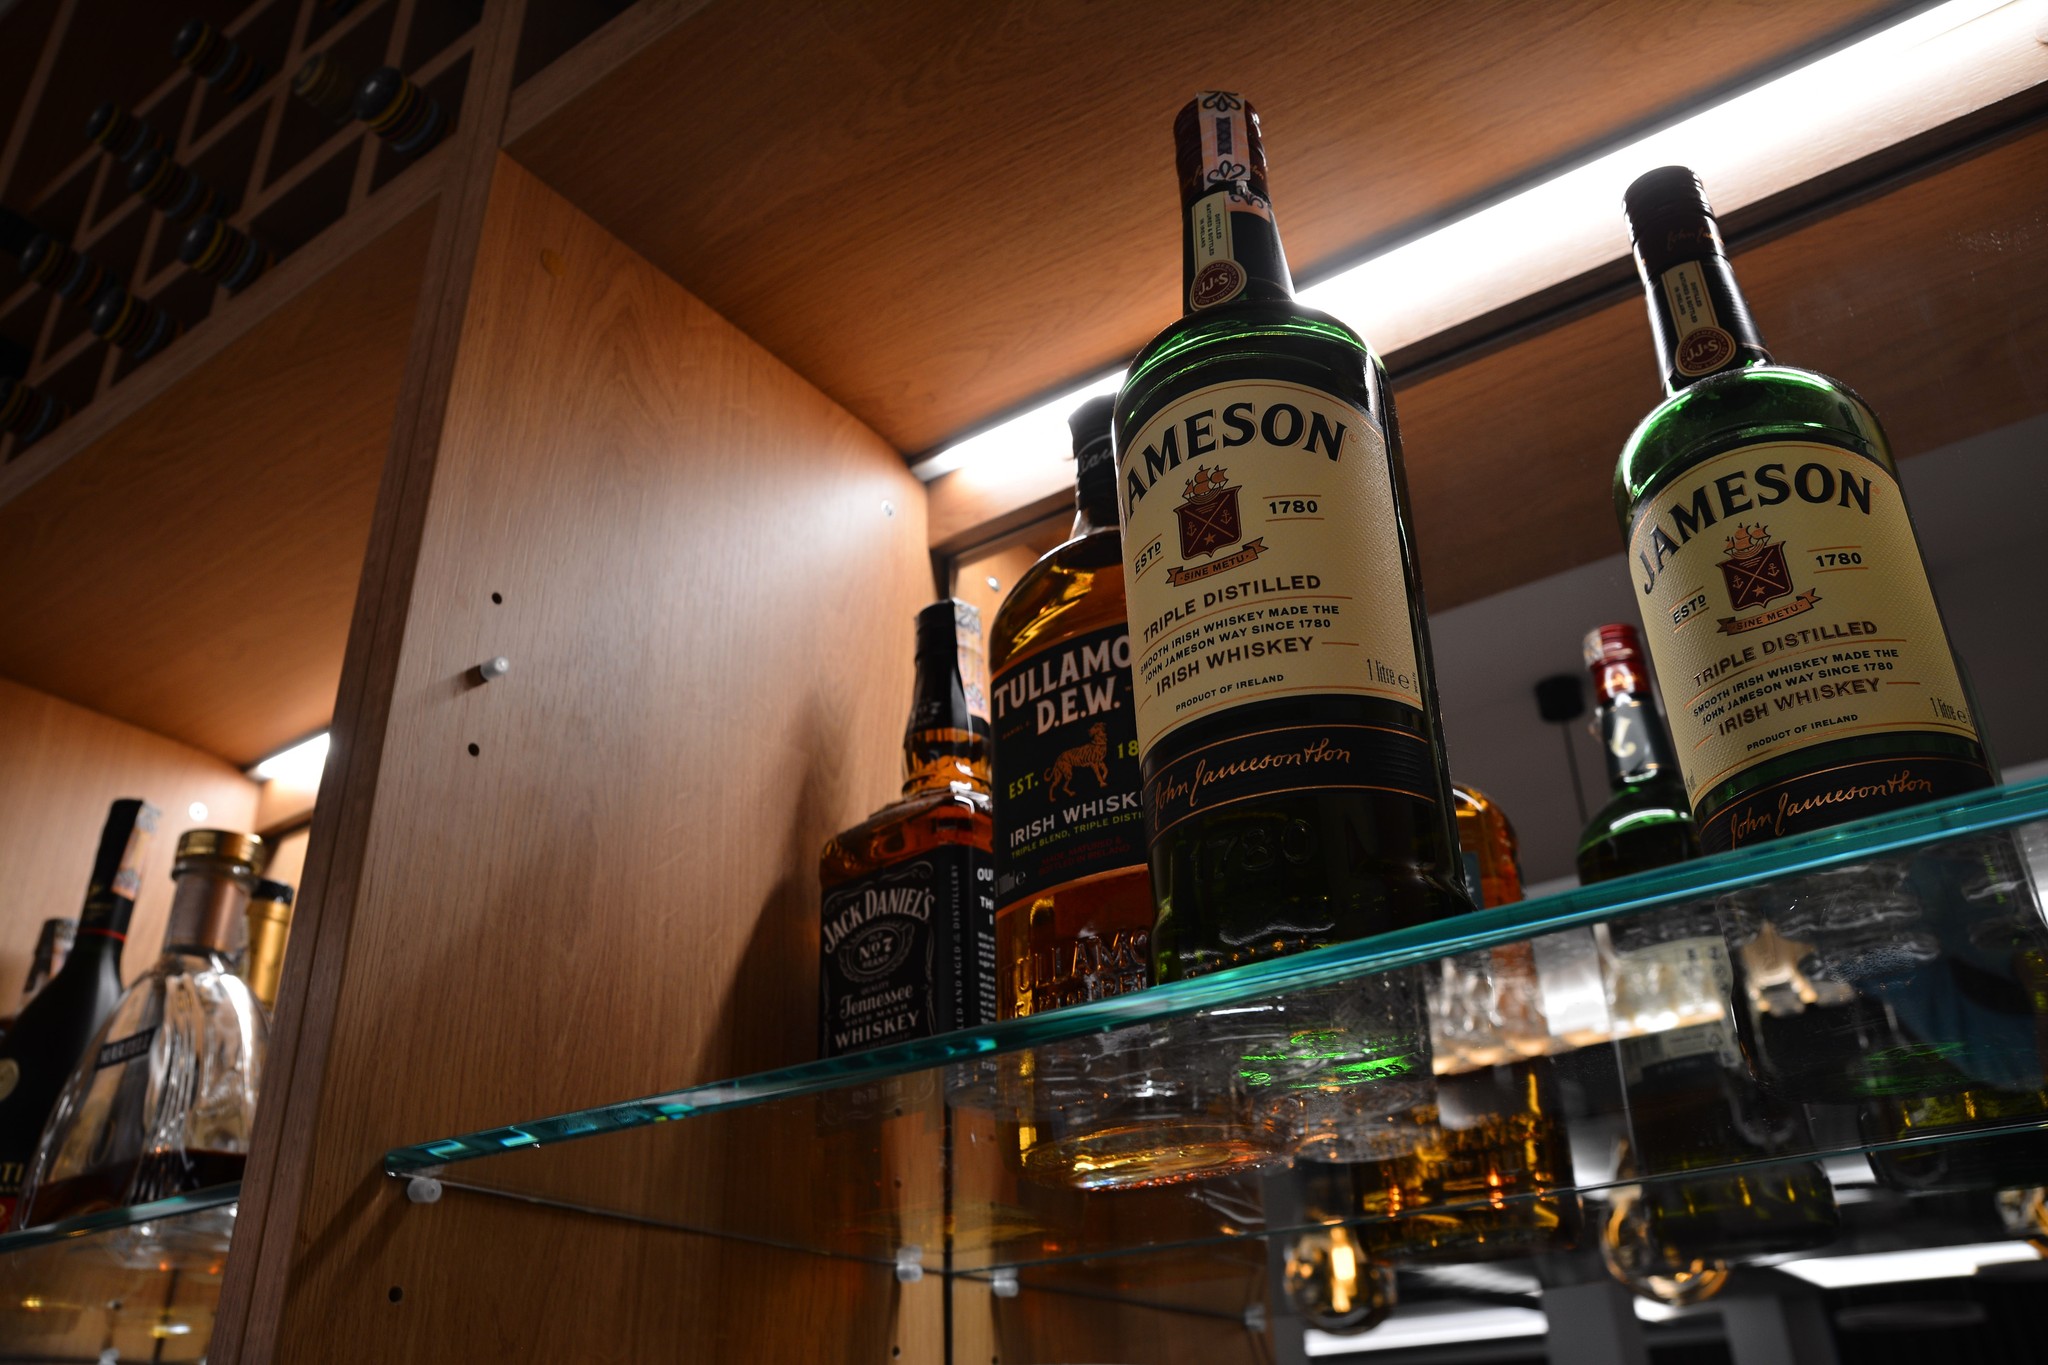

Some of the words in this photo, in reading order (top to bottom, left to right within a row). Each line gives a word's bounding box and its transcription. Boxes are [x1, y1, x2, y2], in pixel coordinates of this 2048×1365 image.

[1126, 402, 1347, 520] AMESON
[1270, 500, 1318, 514] 1780
[1639, 462, 1872, 595] JAMESON
[1816, 552, 1862, 567] 1780
[1144, 599, 1196, 643] TRIPLE
[1204, 575, 1320, 608] DISTILLED
[1141, 644, 1168, 675] SMOOTH
[1172, 628, 1200, 648] IRISH
[1204, 610, 1264, 633] WHISKEY
[1269, 606, 1308, 618] MADE
[1313, 606, 1339, 614] THE
[1145, 665, 1162, 684] JOHN
[1165, 637, 1215, 667] JAMESON
[1219, 628, 1247, 642] WAY
[1252, 620, 1294, 634] SINCE
[1299, 619, 1330, 628] 1780
[1156, 660, 1200, 696] IRISH
[1206, 636, 1313, 669] WHISKEY
[1694, 647, 1756, 687] TRIPLE
[1762, 621, 1877, 655] DISTILLED
[1176, 689, 1216, 712] PRODUCT
[1220, 684, 1233, 694] OF
[1236, 674, 1284, 689] IRELAND
[1367, 658, 1372, 681] 1
[1376, 660, 1395, 685] litre
[1694, 688, 1730, 717] SMOOTH
[1733, 674, 1764, 693] IRISH
[1767, 656, 1828, 679] WHISKEY
[1833, 650, 1870, 662] MADE
[1874, 649, 1898, 657] THE
[1703, 706, 1724, 725] JOHN
[1728, 682, 1782, 710] JAMESON
[1786, 672, 1814, 687] WAY
[1819, 664, 1860, 678] SINCE
[1864, 662, 1893, 672] 1780
[1036, 675, 1121, 736] D.E.W.
[1719, 703, 1769, 736] IRISH
[1774, 678, 1879, 711] WHISKEY
[1747, 729, 1791, 751] PRODUCT
[1794, 725, 1808, 734] OF
[1811, 714, 1858, 730] IRELAND
[1930, 697, 1938, 717] 1
[1938, 698, 1957, 721] litre
[1008, 772, 1039, 800] EST.
[1010, 814, 1055, 848] IRISH
[1062, 790, 1144, 824] WHISK
[1011, 842, 1037, 859] TRIPLE
[1073, 818, 1109, 834] TRIPLE
[823, 901, 863, 954] JACK
[864, 886, 936, 921] DANIEL'S
[950, 864, 960, 929] DISTILLERY
[883, 937, 894, 952] 7
[835, 1010, 920, 1049] WHISKEY
[840, 984, 913, 1020] Tennessee
